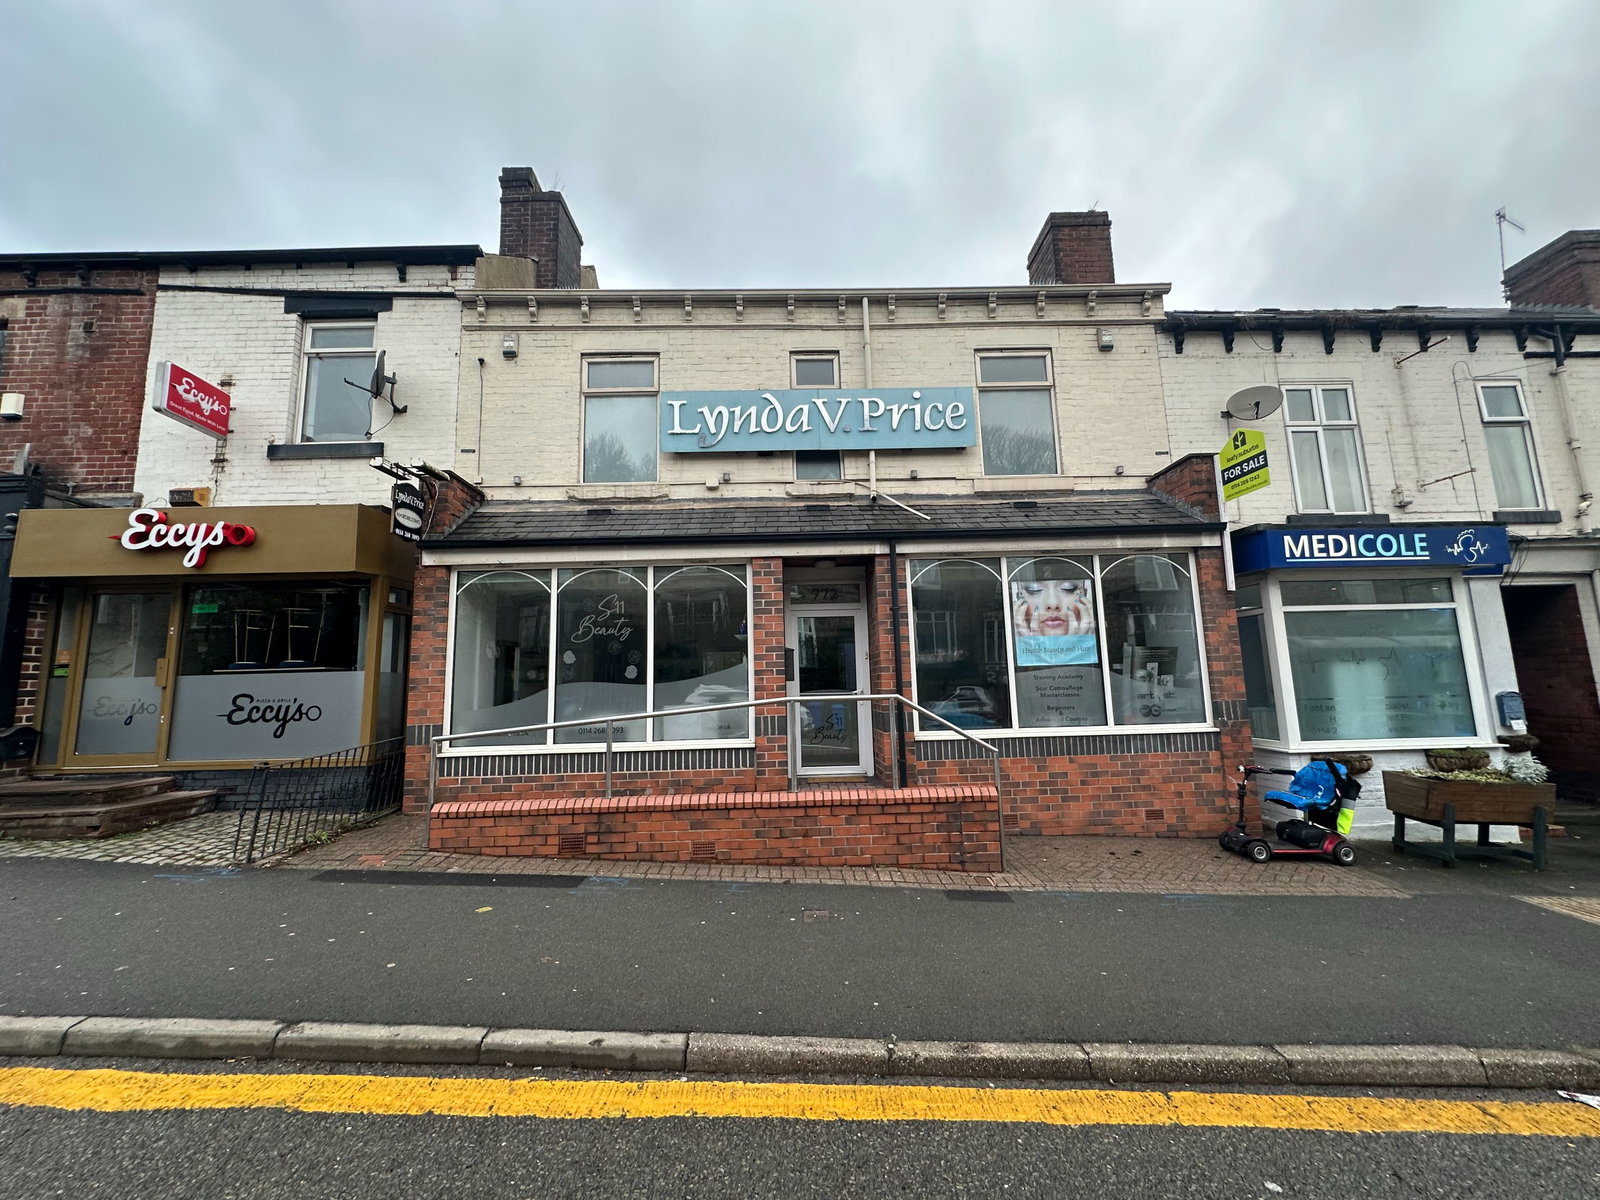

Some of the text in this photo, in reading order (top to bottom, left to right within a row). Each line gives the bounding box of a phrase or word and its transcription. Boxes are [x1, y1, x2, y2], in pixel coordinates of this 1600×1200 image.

[176, 377, 219, 416] Eccy's
[667, 392, 812, 448] Lynda
[857, 390, 967, 432] Price
[1226, 443, 1260, 463] leafysuburbs
[1224, 454, 1265, 481] FOR SALE
[1230, 482, 1240, 490] 0114
[121, 508, 225, 568] Eccys
[1283, 533, 1430, 558] MEDICOLE
[571, 614, 634, 643] Beauty
[1049, 684, 1083, 692] Camouflage
[1057, 673, 1084, 681] Academy
[227, 693, 304, 739] Eccy's
[577, 727, 592, 735] 0114
[810, 726, 848, 744] Beauty
